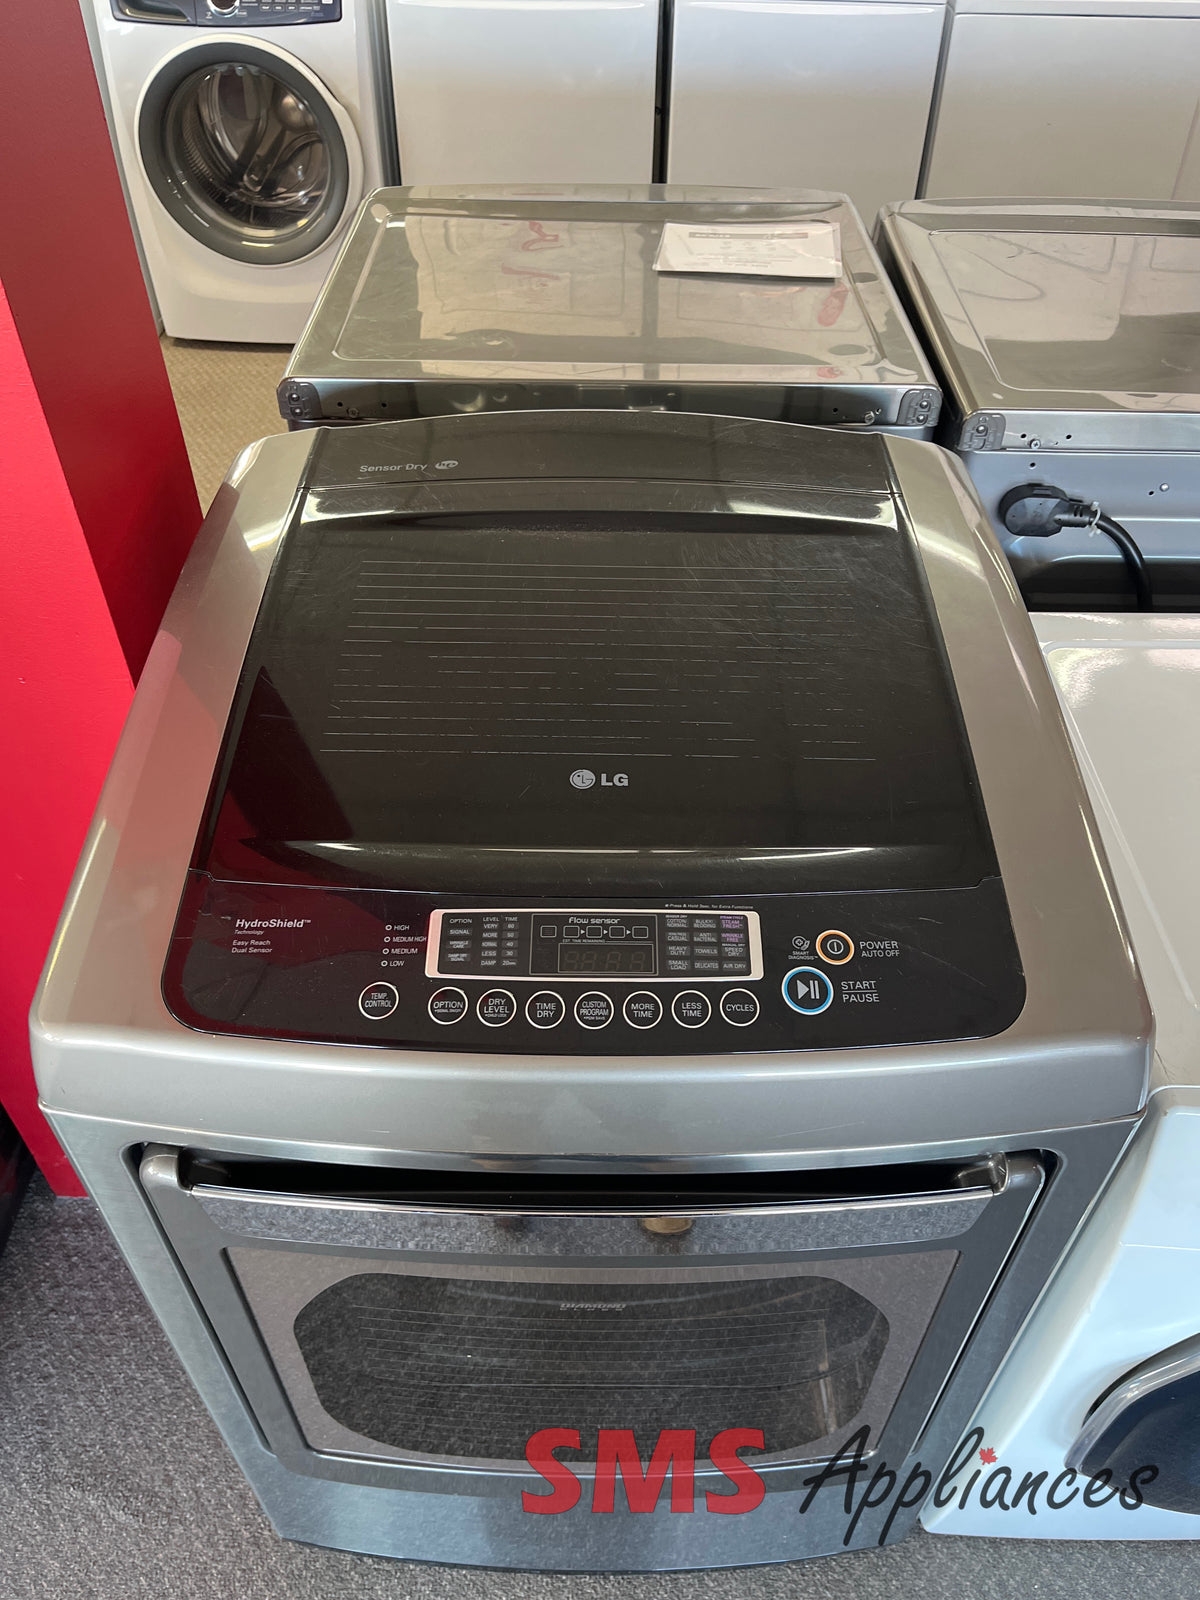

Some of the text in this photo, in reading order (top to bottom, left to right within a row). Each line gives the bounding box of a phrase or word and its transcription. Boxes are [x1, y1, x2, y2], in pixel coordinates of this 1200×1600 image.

[601, 774, 628, 786] LG
[860, 941, 899, 949] POWER
[841, 981, 876, 990] START
[842, 993, 880, 1003] PAUSE
